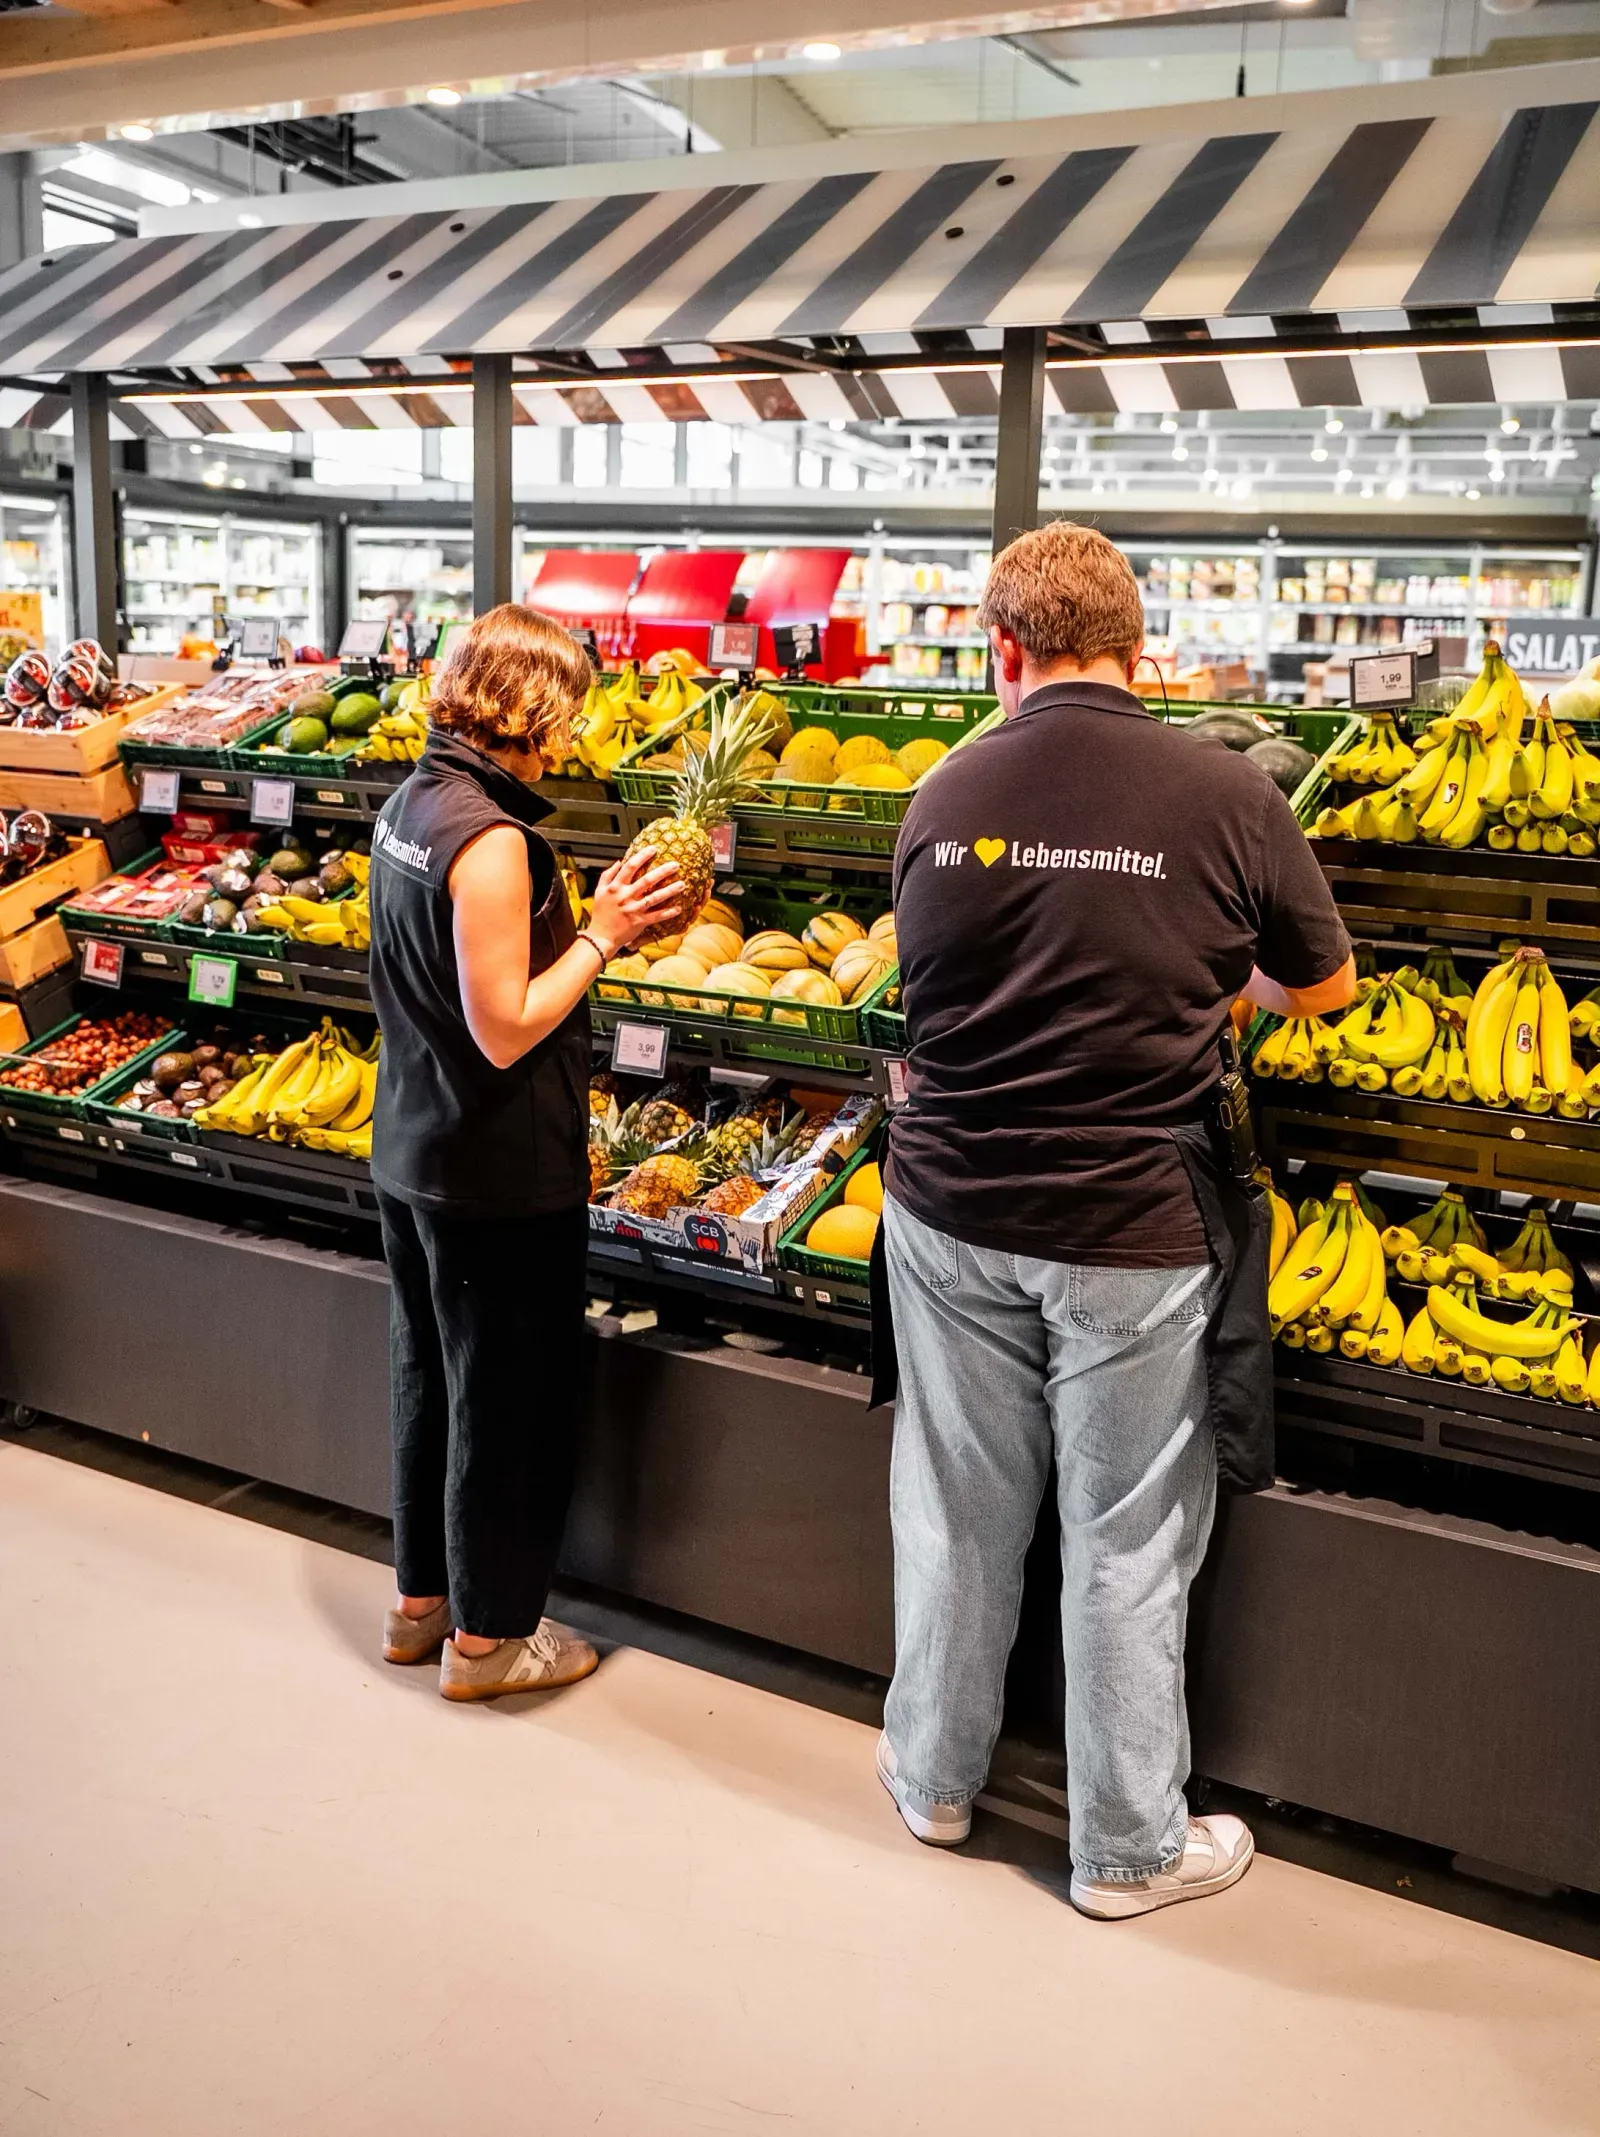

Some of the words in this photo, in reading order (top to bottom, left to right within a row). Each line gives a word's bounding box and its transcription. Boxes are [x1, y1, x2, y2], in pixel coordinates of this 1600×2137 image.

[1507, 632, 1599, 670] SALAT
[1380, 672, 1402, 684] 1,99
[934, 841, 968, 867] Wir
[1010, 841, 1167, 880] Lebensmittel.
[637, 1042, 656, 1053] 3,99
[690, 1222, 720, 1238] SCB
